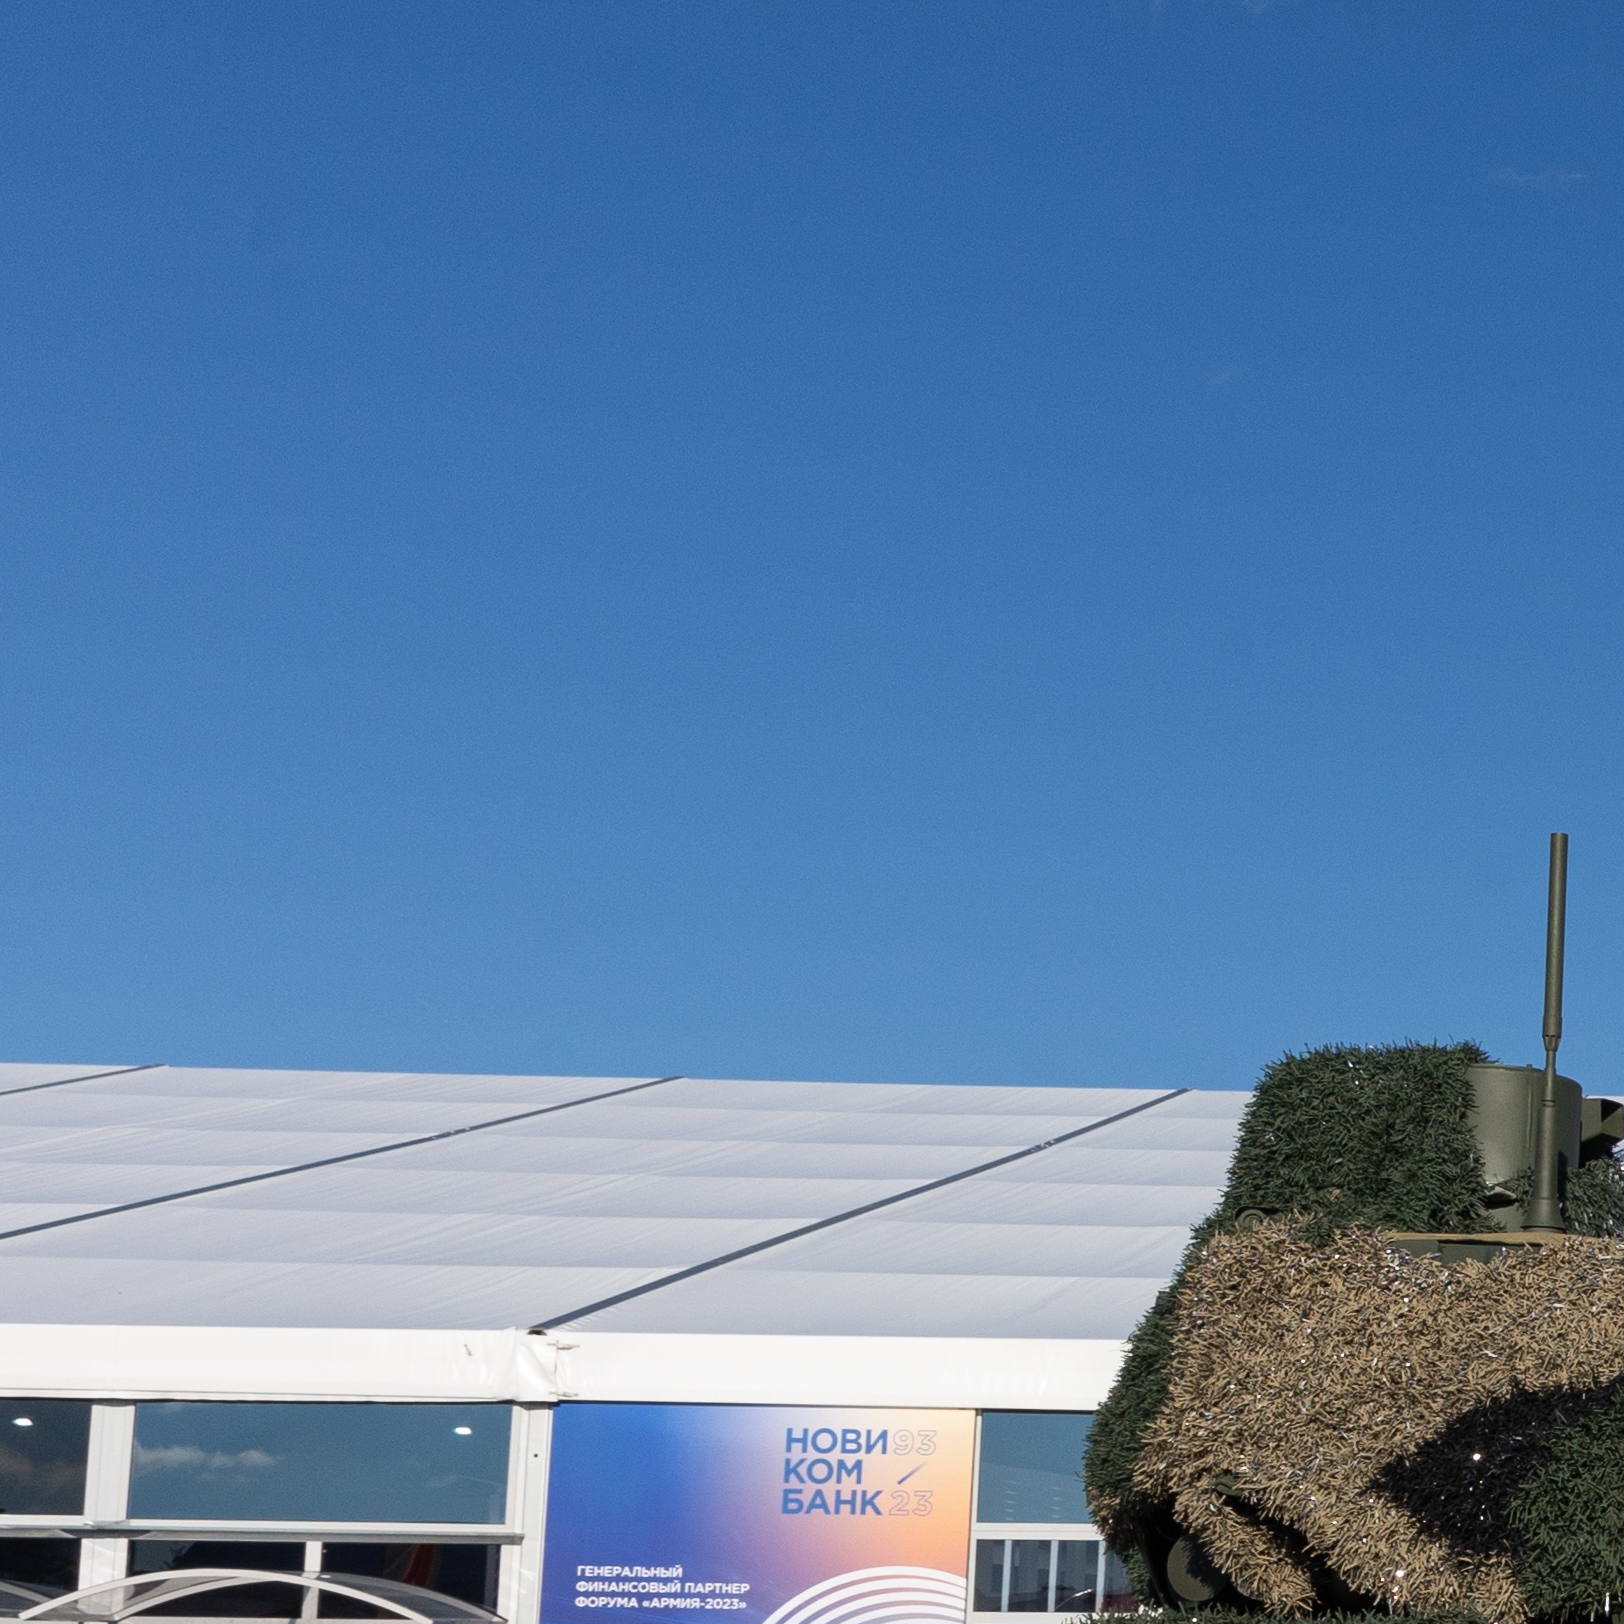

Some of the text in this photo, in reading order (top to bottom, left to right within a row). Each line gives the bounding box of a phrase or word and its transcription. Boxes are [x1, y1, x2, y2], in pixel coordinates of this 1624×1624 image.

[786, 1428, 937, 1456] НОВИ 93
[783, 1459, 863, 1485] КОМ
[781, 1488, 934, 1517] БАНК 23
[576, 1564, 683, 1578] ГЕНЕРАЛЬНЫЙ
[575, 1579, 750, 1594] ФИНАНСОВЫЙ ПАРТНЕР
[574, 1595, 748, 1610] ФОРУМА «АРМИЯ-2023»
